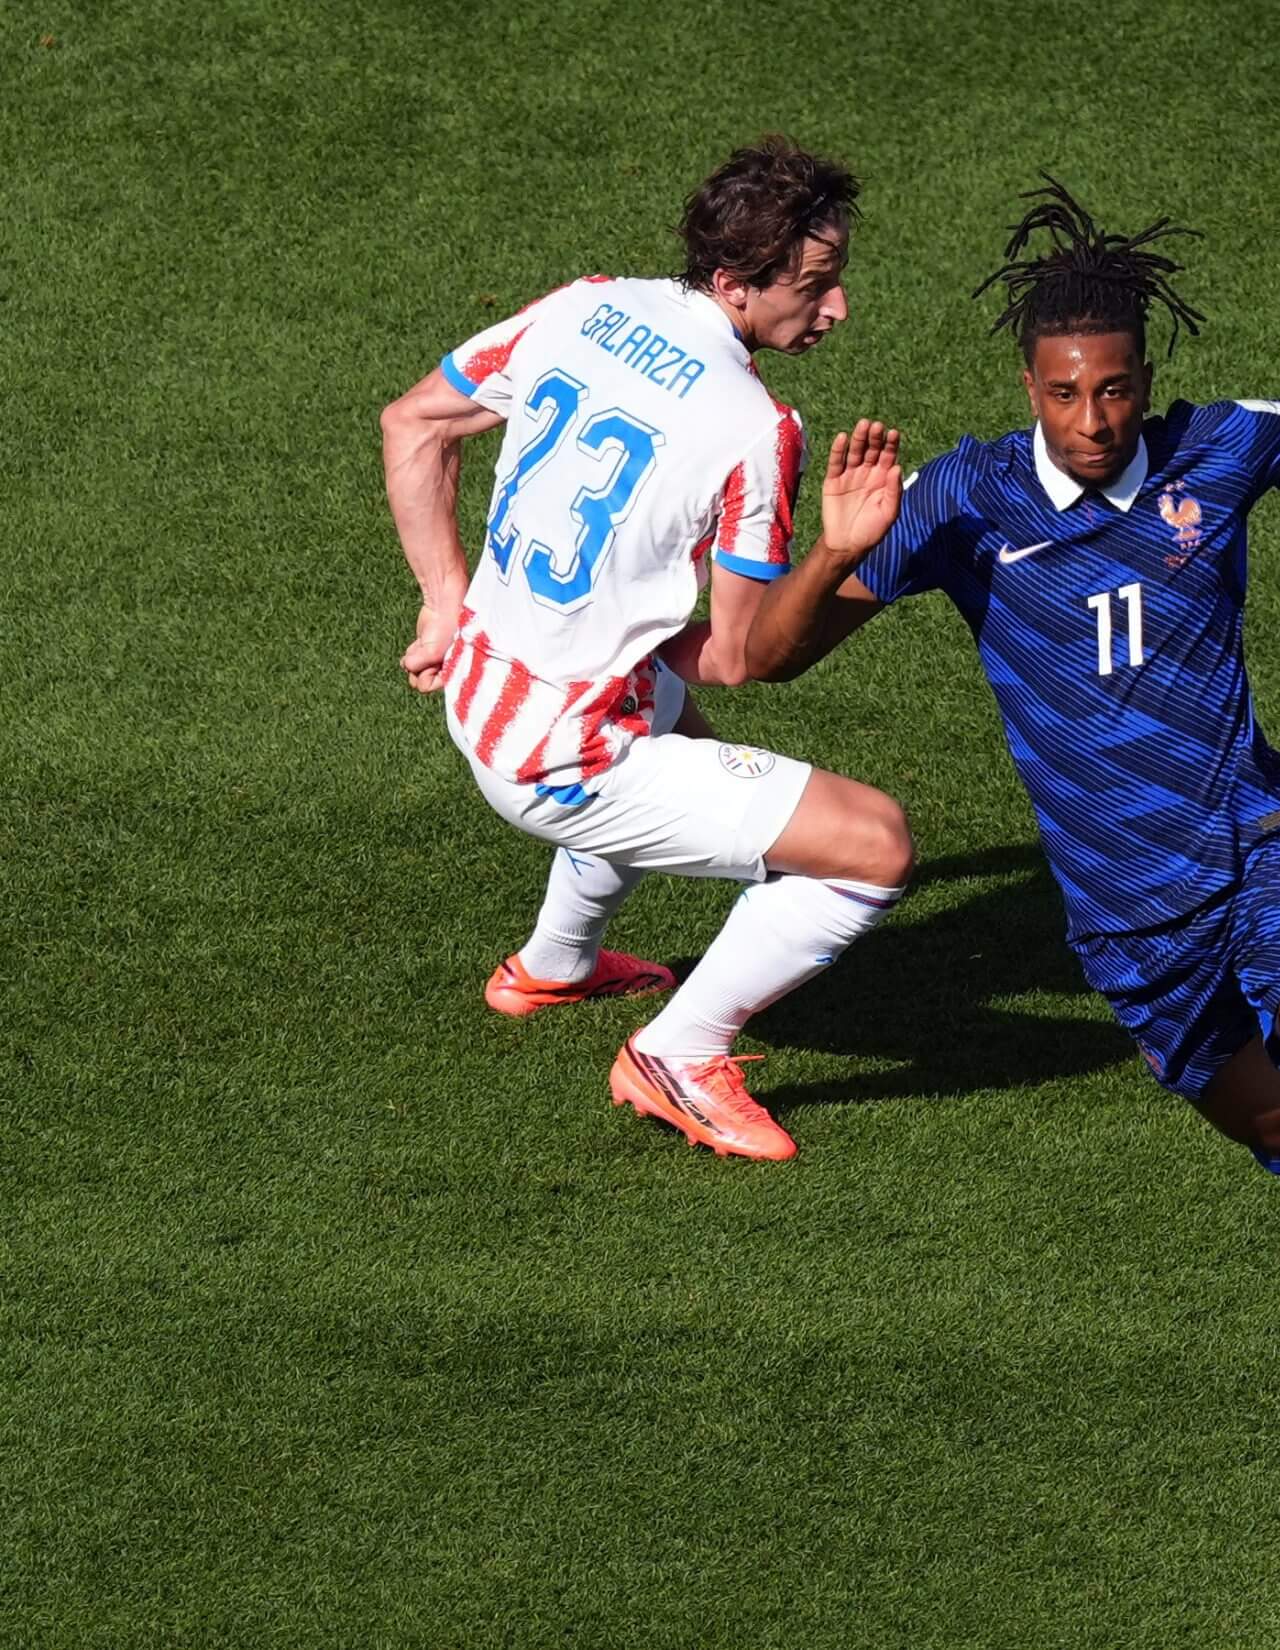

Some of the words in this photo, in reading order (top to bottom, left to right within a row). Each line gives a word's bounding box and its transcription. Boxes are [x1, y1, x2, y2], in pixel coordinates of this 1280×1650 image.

[581, 303, 706, 399] GALARZA
[487, 367, 666, 616] 23
[1087, 582, 1144, 676] 11
